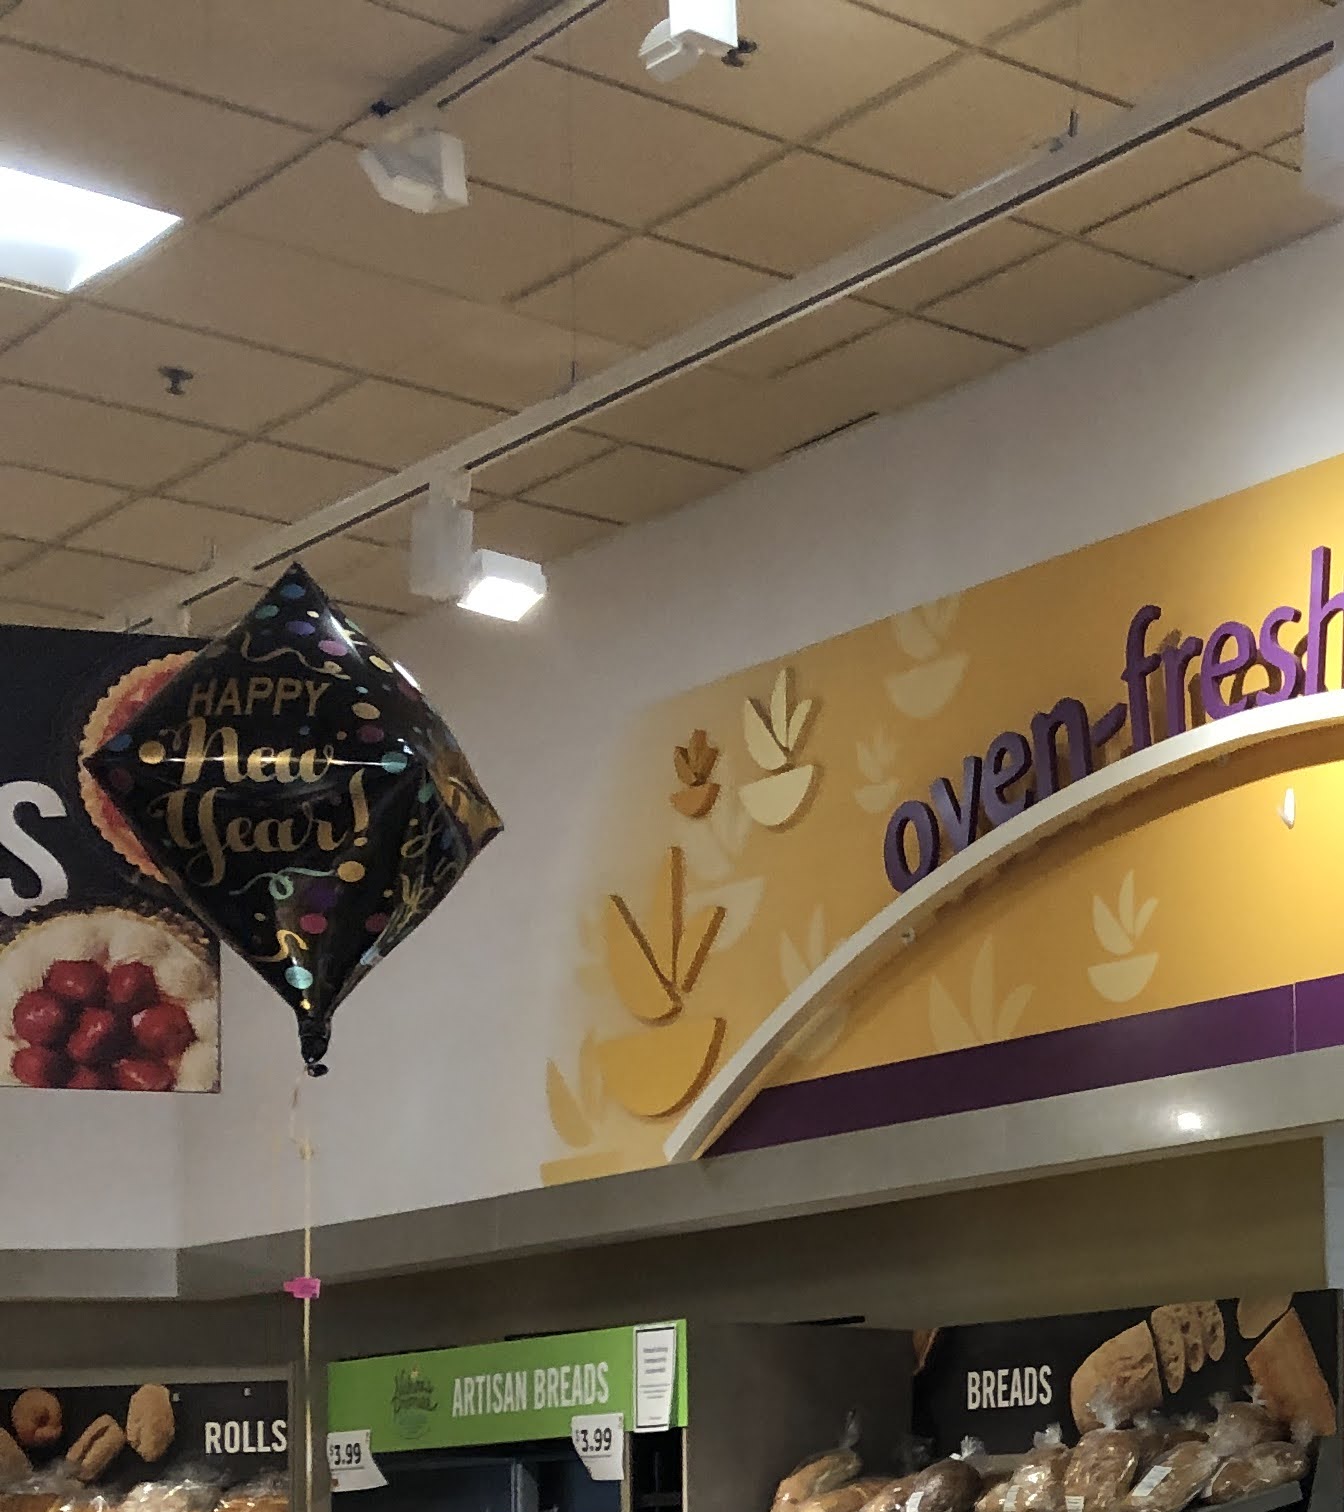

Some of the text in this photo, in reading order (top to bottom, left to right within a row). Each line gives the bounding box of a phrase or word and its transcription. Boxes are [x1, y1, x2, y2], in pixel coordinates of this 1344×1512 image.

[187, 677, 331, 717] HAPPY
[160, 716, 334, 785] New
[150, 768, 370, 887] Year!
[452, 1371, 527, 1418] ARTISAN
[534, 1362, 609, 1410] BREADS
[967, 1364, 1052, 1410] BREADS
[204, 1419, 287, 1454] ROLLS
[329, 1442, 361, 1466] $3.99
[575, 1427, 613, 1452] $3.99
